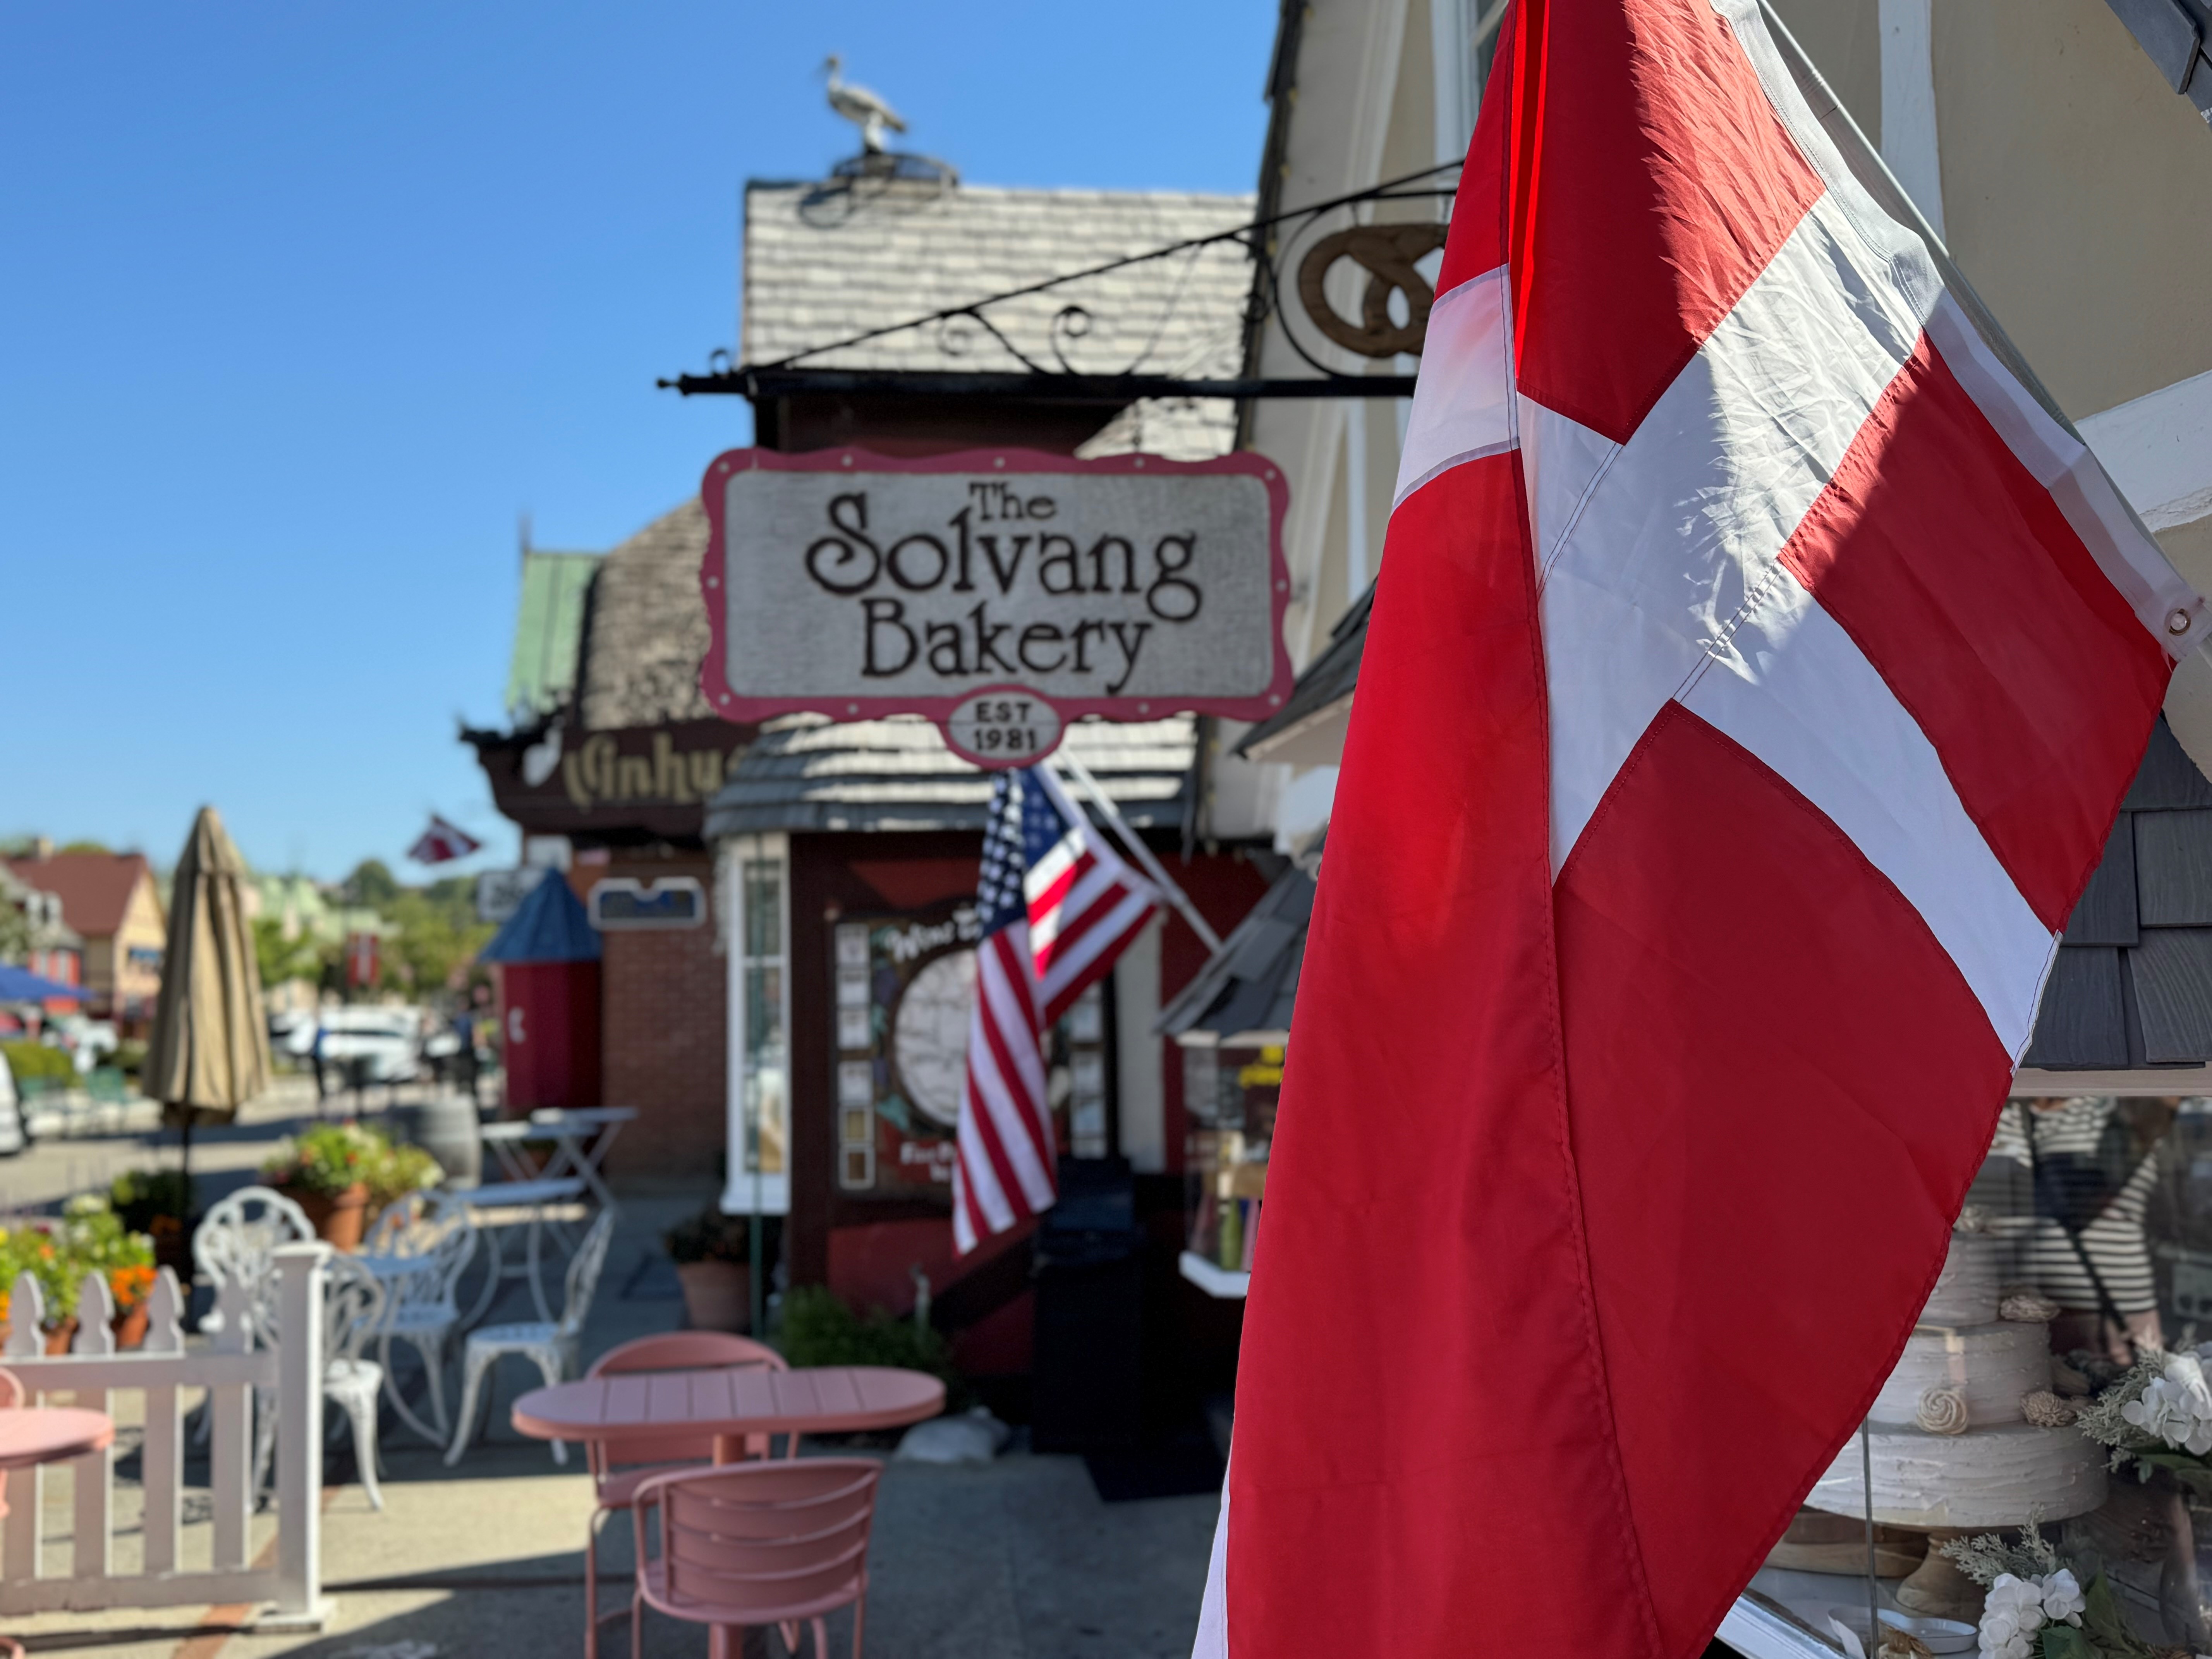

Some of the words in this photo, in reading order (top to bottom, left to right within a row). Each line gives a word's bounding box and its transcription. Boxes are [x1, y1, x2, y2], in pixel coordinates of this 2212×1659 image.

[969, 481, 1057, 522] The
[804, 491, 1204, 625] Solvang
[860, 597, 1154, 696] Bakery
[974, 728, 1038, 752] 1981
[975, 702, 1032, 723] EST
[562, 732, 747, 810] Vinhu
